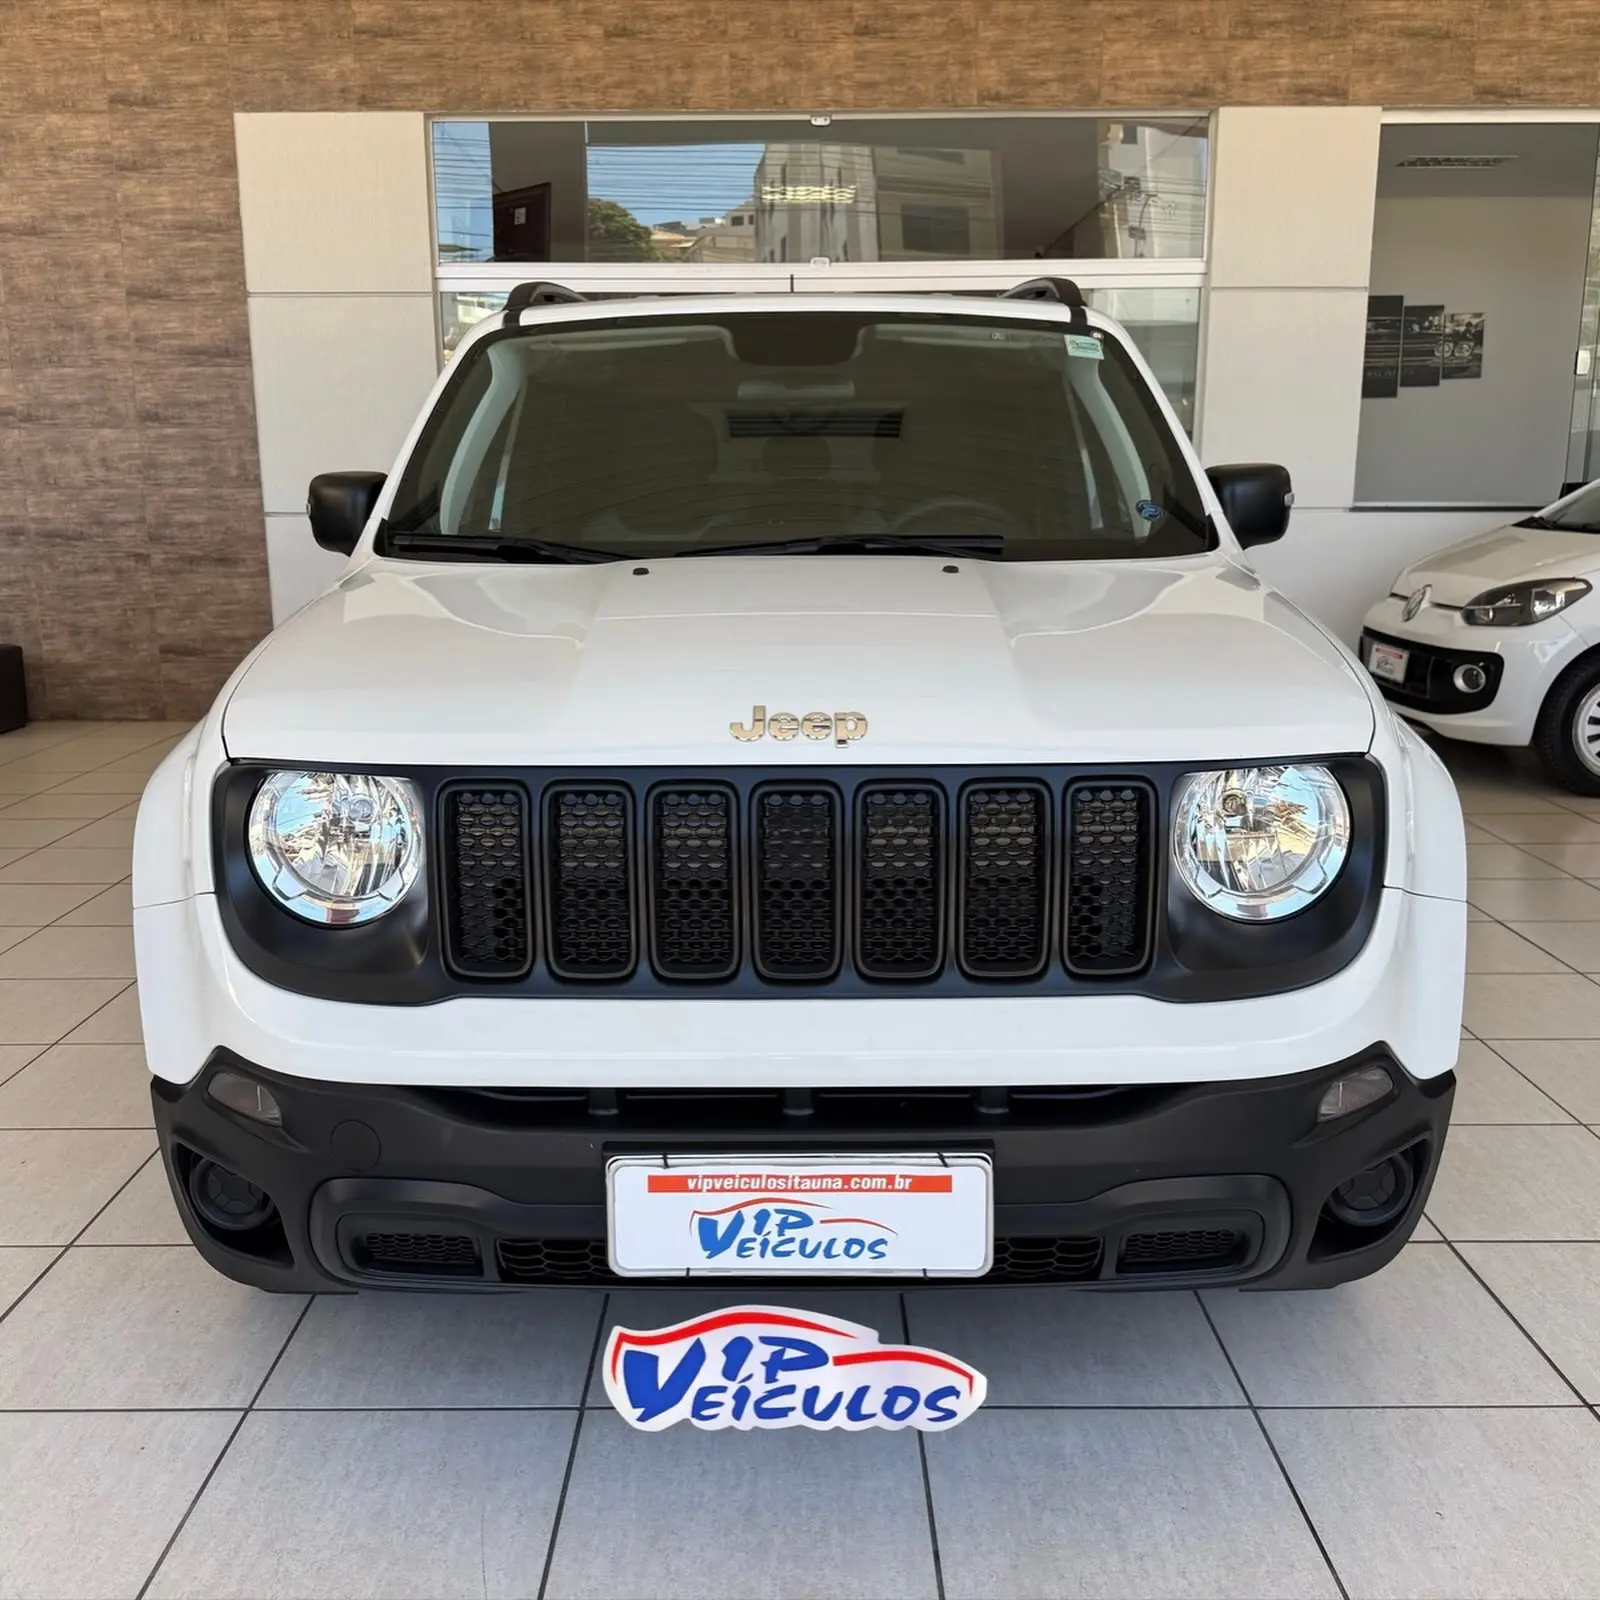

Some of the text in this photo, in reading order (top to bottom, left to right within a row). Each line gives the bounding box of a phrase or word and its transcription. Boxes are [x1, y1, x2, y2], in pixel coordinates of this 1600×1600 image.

[730, 705, 868, 748] Jeep
[687, 1175, 912, 1192] vipveiculositauna.com.br
[698, 1209, 813, 1259] VIP
